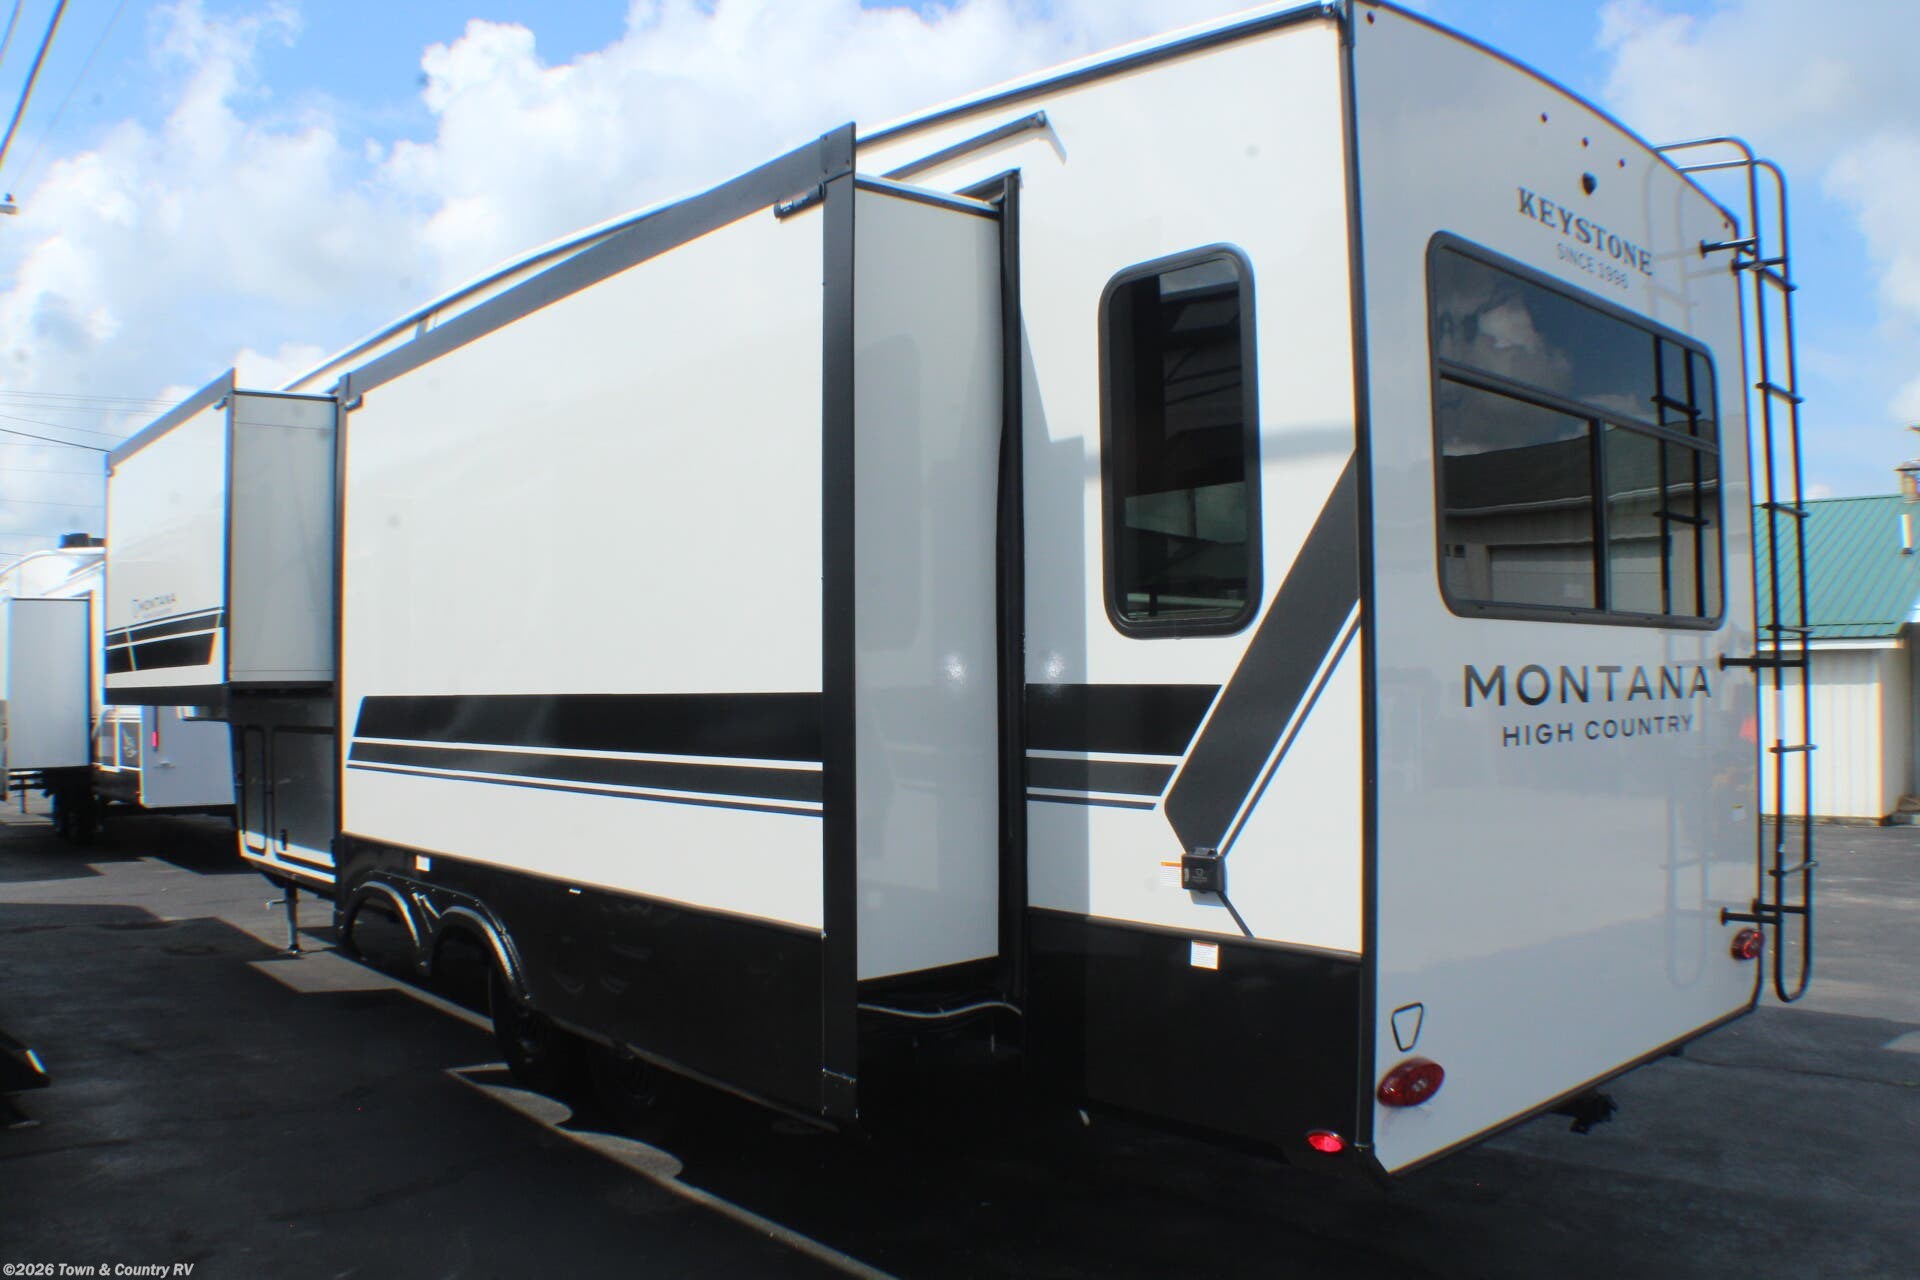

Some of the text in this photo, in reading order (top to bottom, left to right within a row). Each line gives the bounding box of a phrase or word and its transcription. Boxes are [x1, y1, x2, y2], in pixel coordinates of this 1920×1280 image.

[1517, 186, 1653, 276] KEYSTONE
[1556, 242, 1596, 273] SINCE
[1464, 664, 1712, 707] MONTANA
[1503, 713, 1693, 747] HIGH COUNTRY
